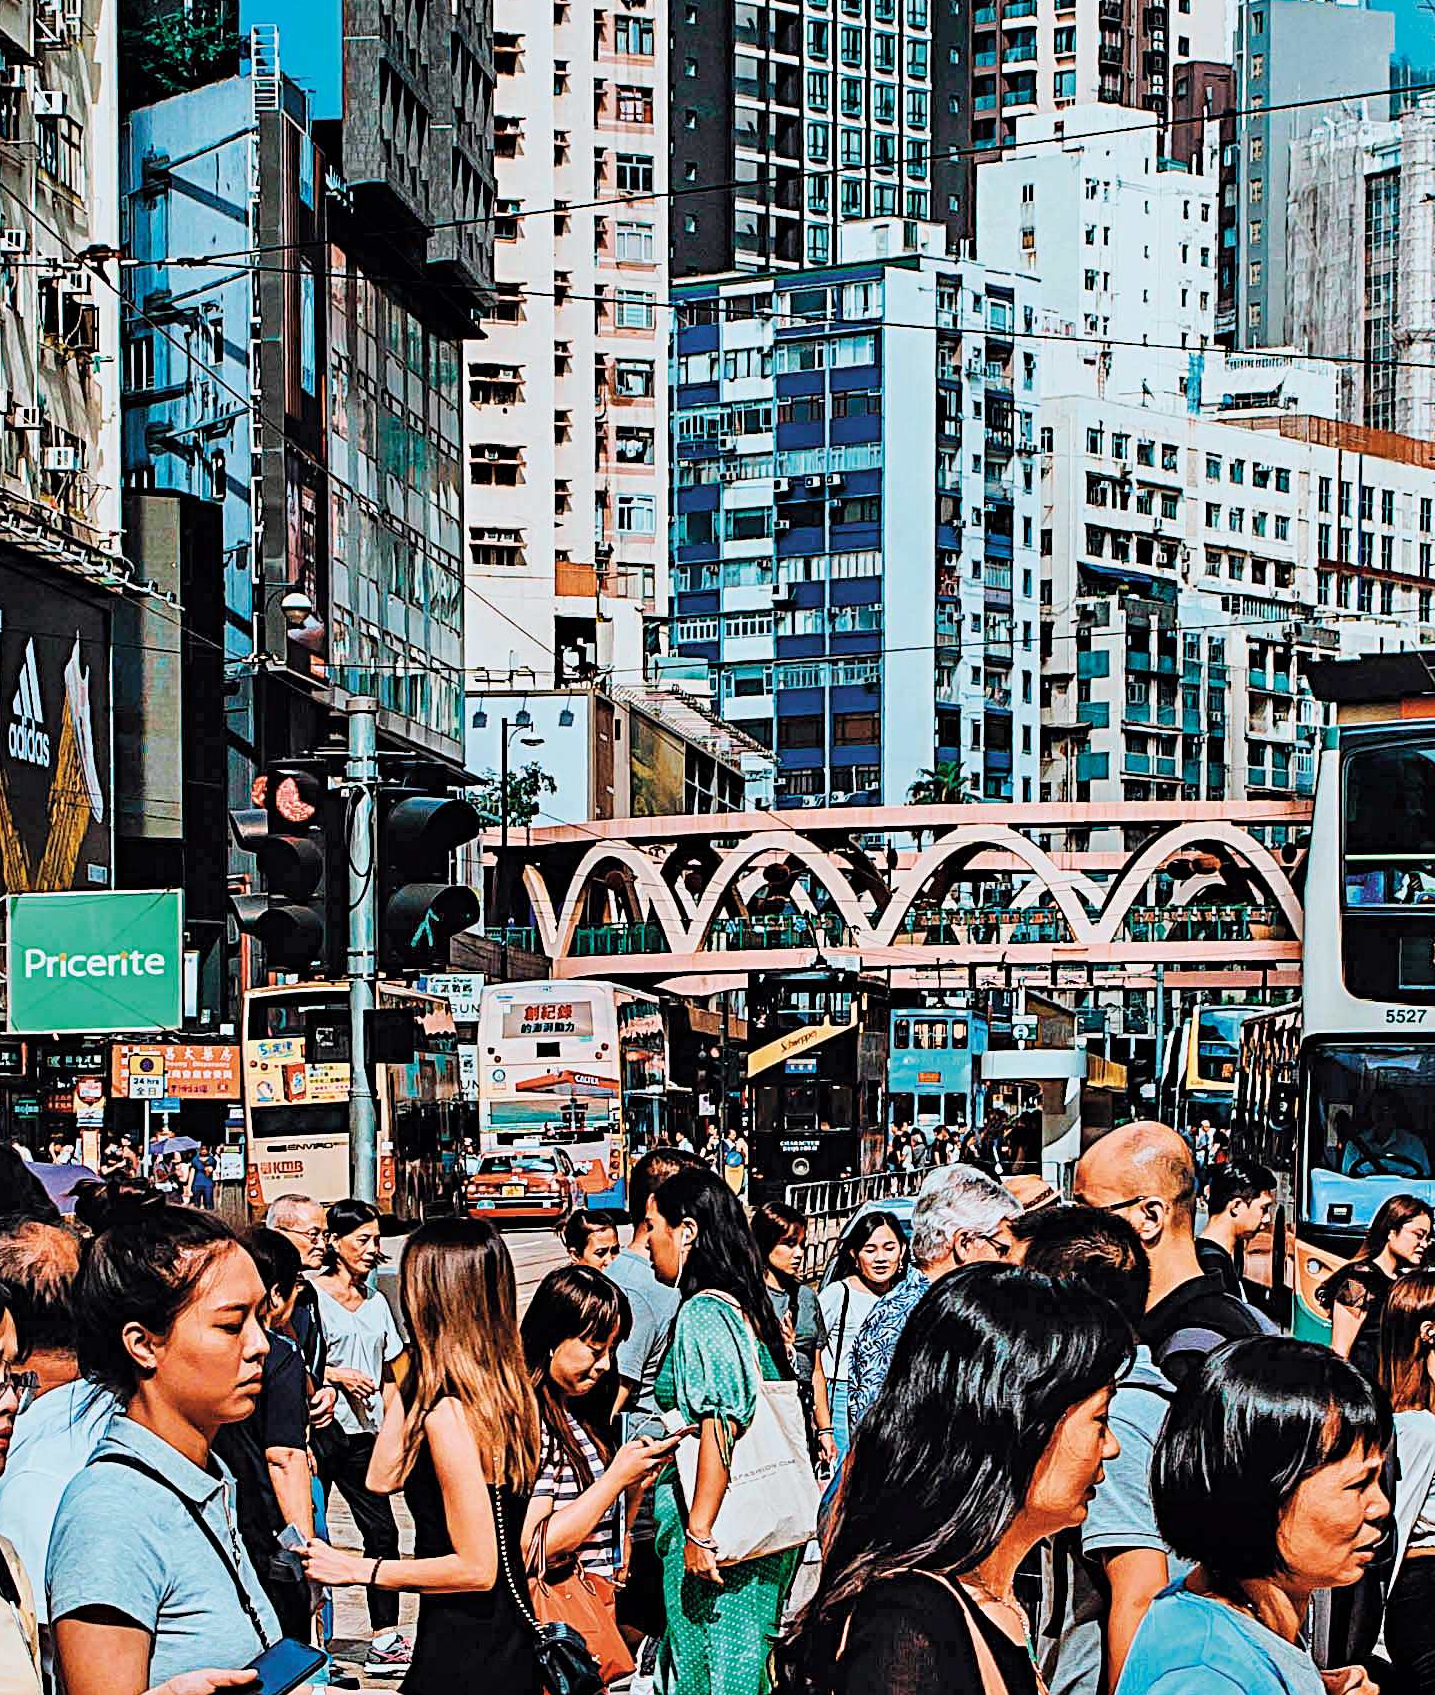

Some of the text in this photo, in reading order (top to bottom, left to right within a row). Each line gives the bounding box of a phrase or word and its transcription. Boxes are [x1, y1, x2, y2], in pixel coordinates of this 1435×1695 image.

[9, 714, 50, 769] adidas
[24, 948, 165, 979] Pricerite
[1385, 1009, 1428, 1025] 5527
[273, 1160, 304, 1175] KMB
